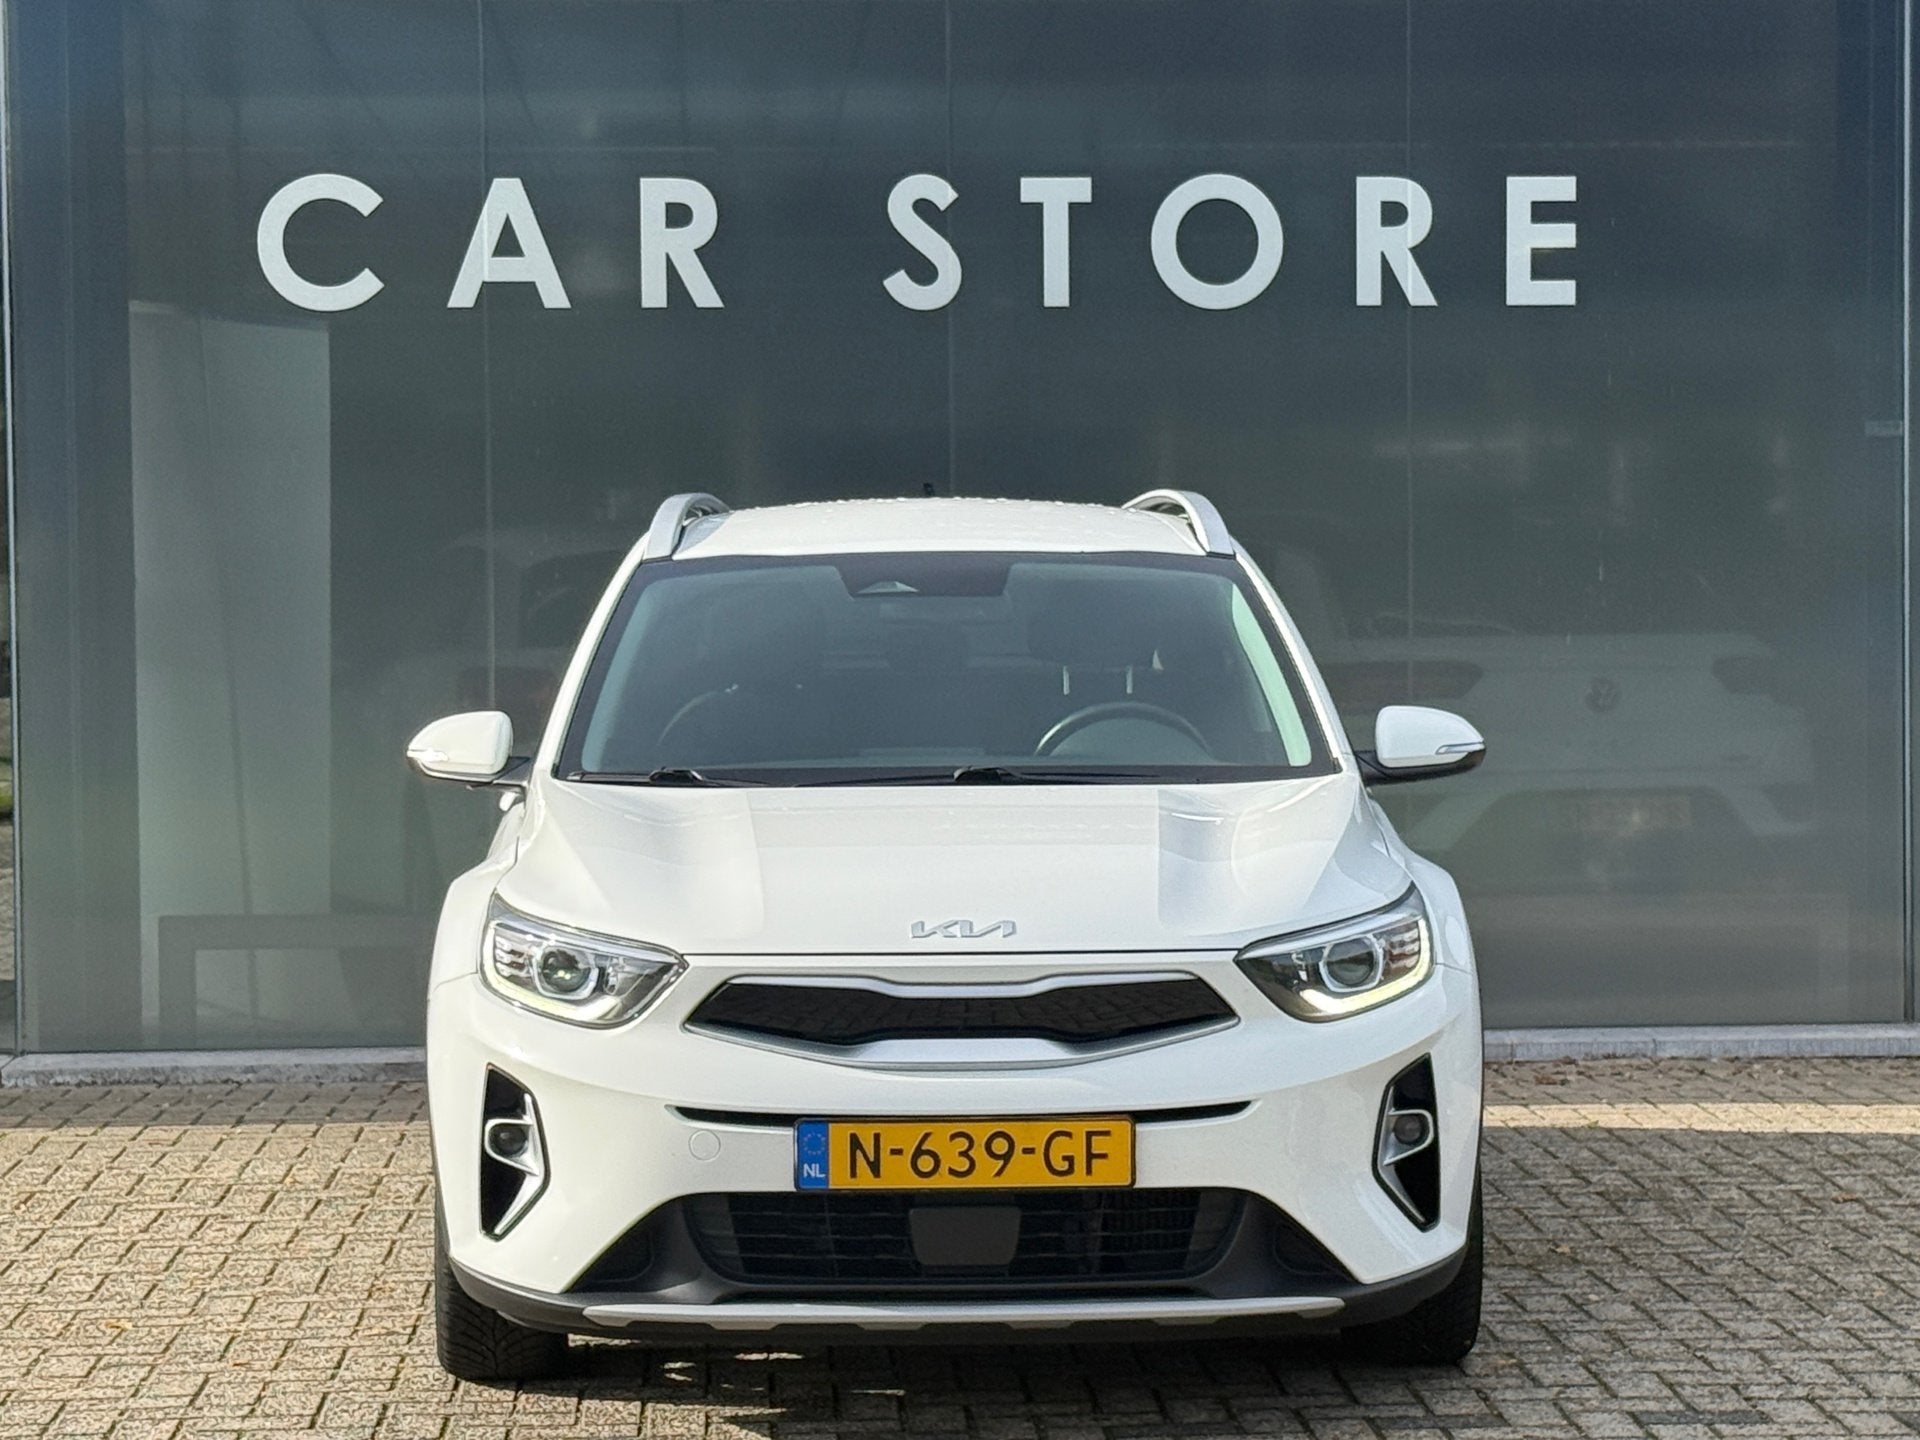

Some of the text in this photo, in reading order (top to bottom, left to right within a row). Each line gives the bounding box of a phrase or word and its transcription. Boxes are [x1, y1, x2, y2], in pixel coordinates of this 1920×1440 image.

[257, 173, 1577, 311] CAR STORE
[910, 919, 1017, 939] KIA
[803, 1163, 826, 1179] NL
[849, 1130, 1112, 1179] N-639-GF
